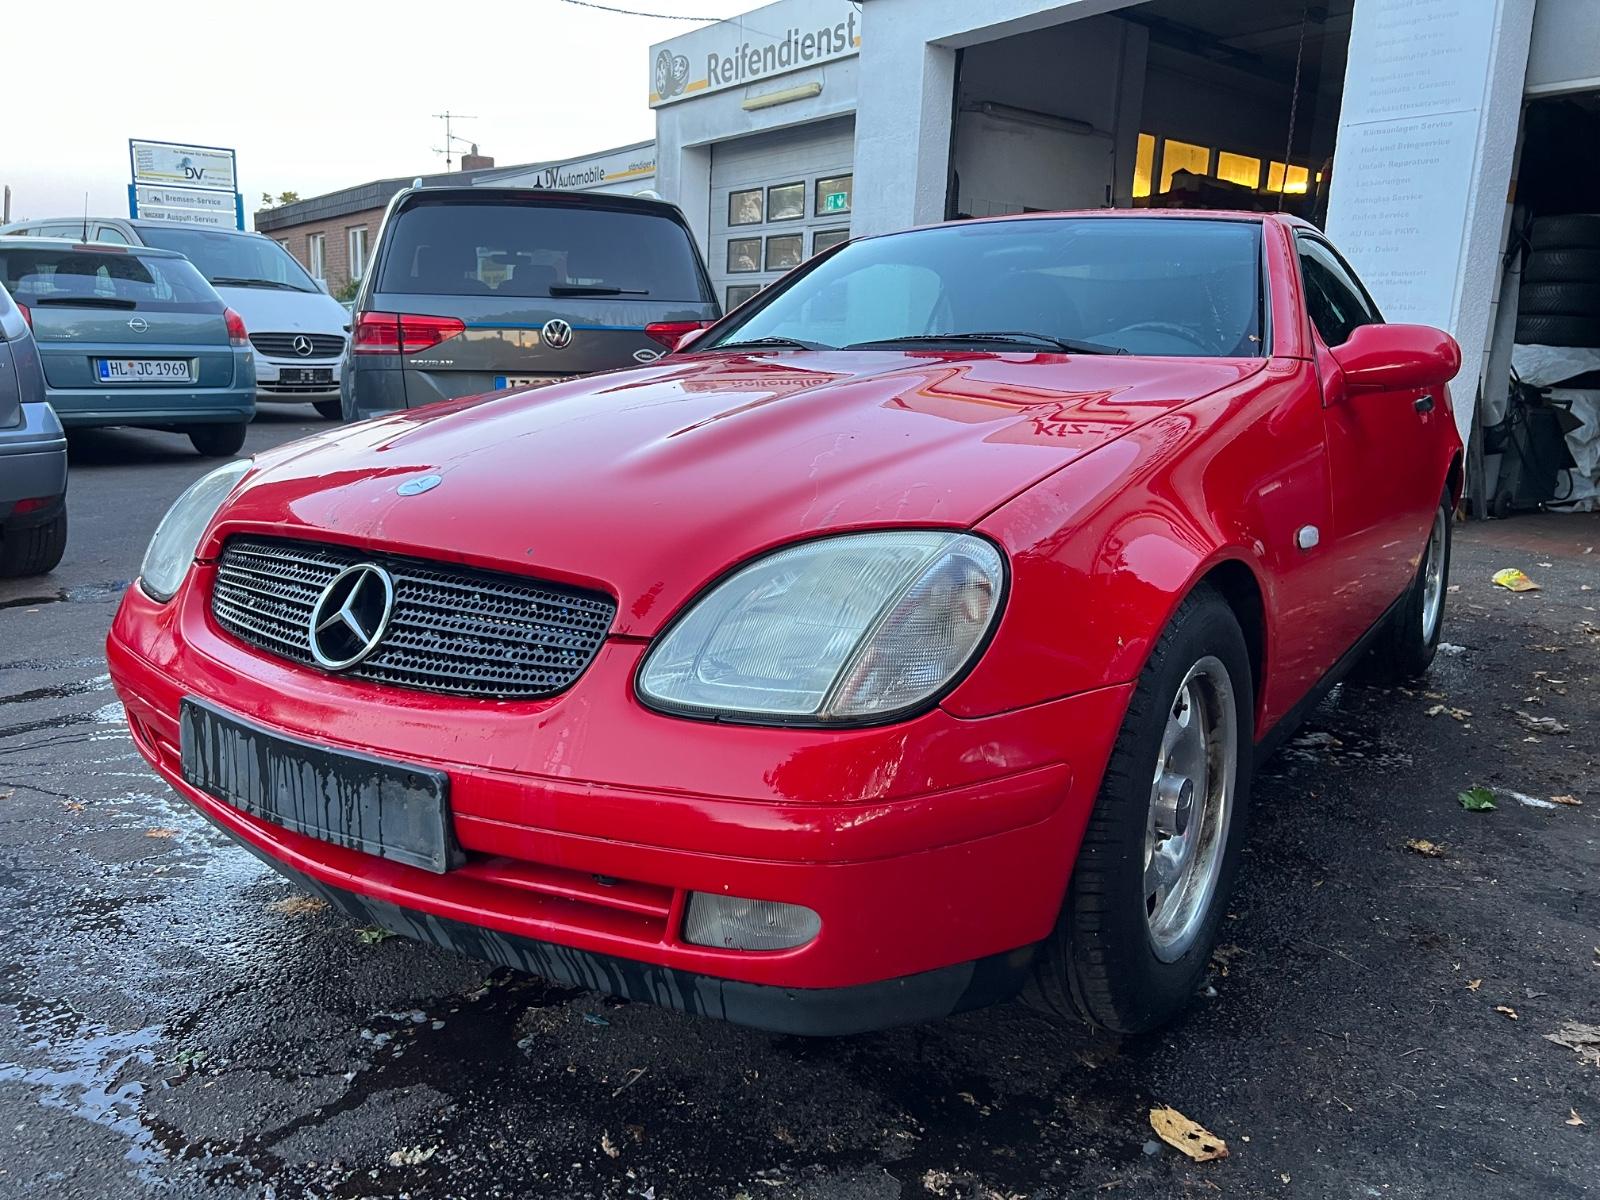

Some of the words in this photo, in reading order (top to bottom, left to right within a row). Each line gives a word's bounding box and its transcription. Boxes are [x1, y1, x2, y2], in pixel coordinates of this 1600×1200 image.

[707, 12, 856, 87] Reifendienst
[1420, 120, 1453, 130] Service
[110, 362, 128, 376] HL
[137, 362, 154, 376] JC
[156, 362, 186, 376] 1969
